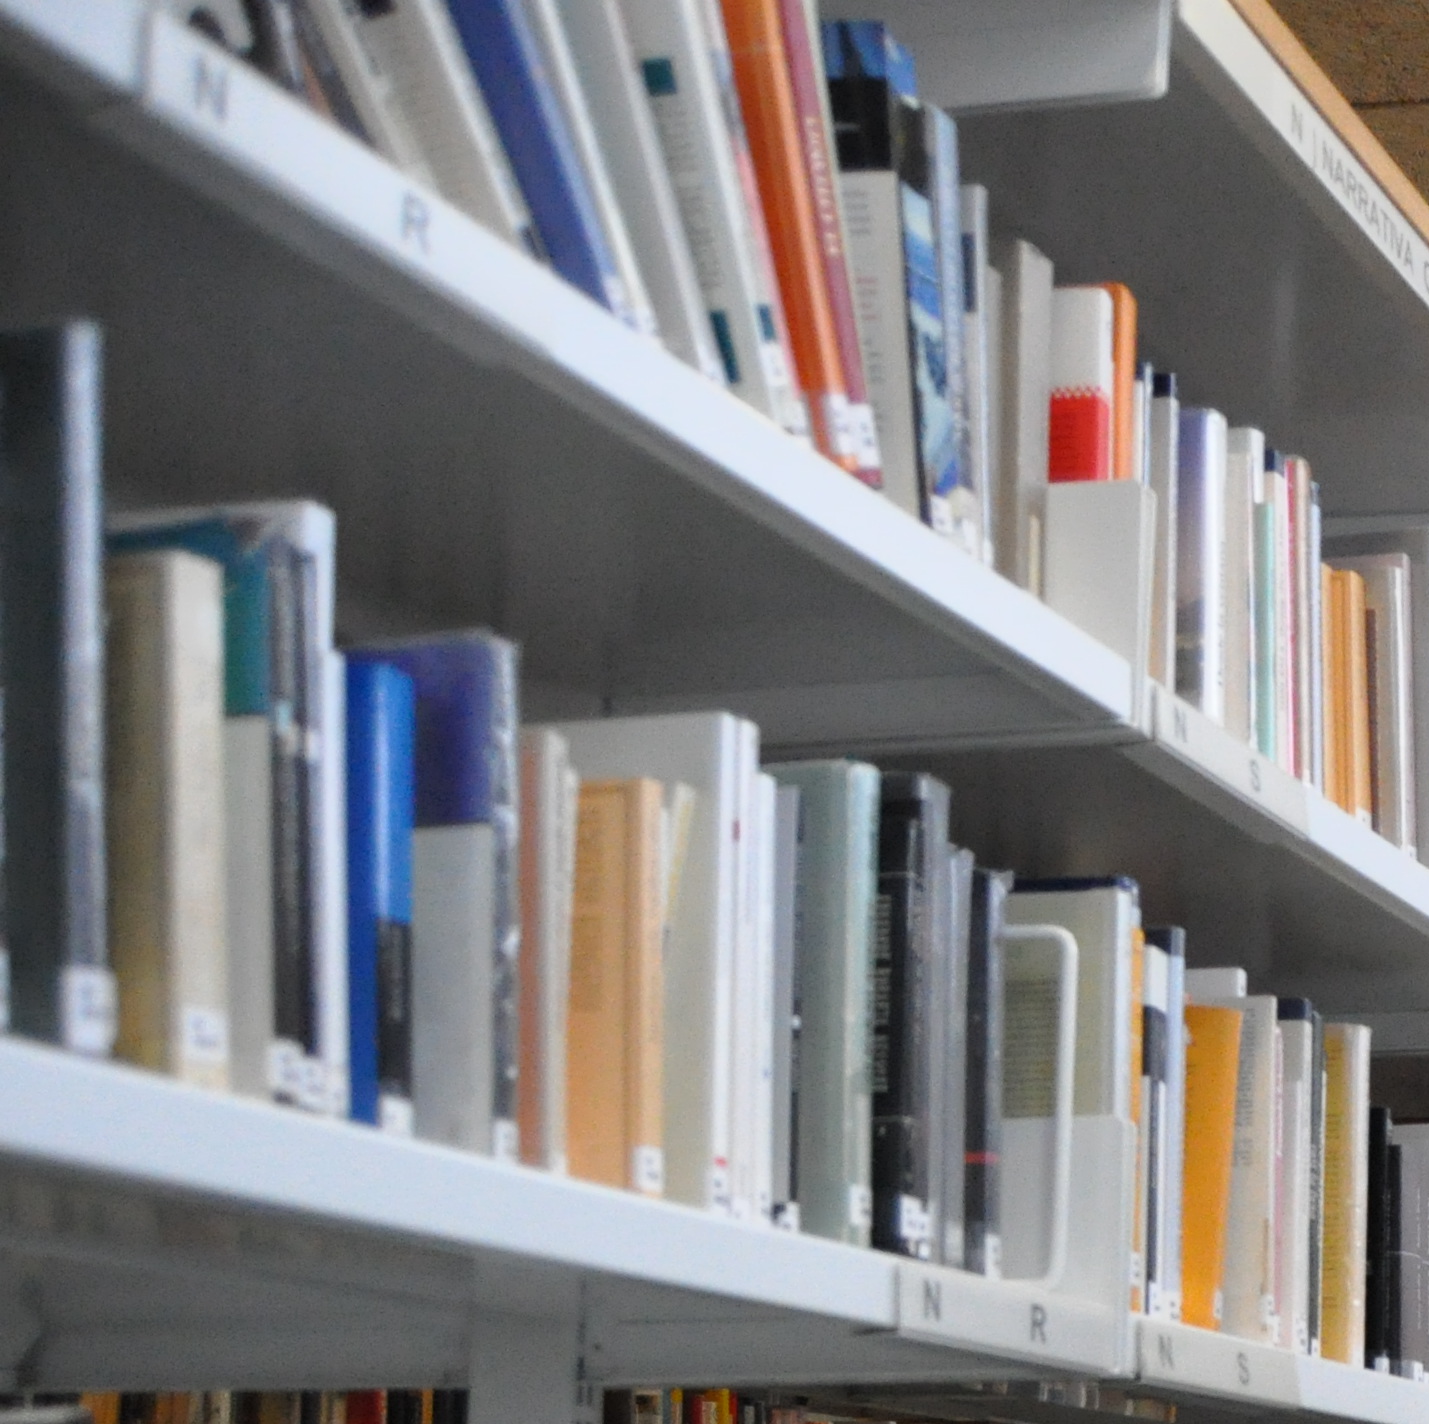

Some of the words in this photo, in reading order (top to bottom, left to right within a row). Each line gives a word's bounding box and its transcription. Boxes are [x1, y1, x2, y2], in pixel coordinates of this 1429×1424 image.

[193, 60, 230, 122] N
[400, 191, 431, 256] R
[1290, 101, 1305, 138] N
[1321, 136, 1416, 277] NARRATIVA
[1174, 706, 1189, 743] N
[1248, 757, 1263, 793] S
[923, 1279, 942, 1323] N
[1030, 1305, 1048, 1344] R
[1158, 1334, 1175, 1370] N
[1237, 1352, 1251, 1387] S
